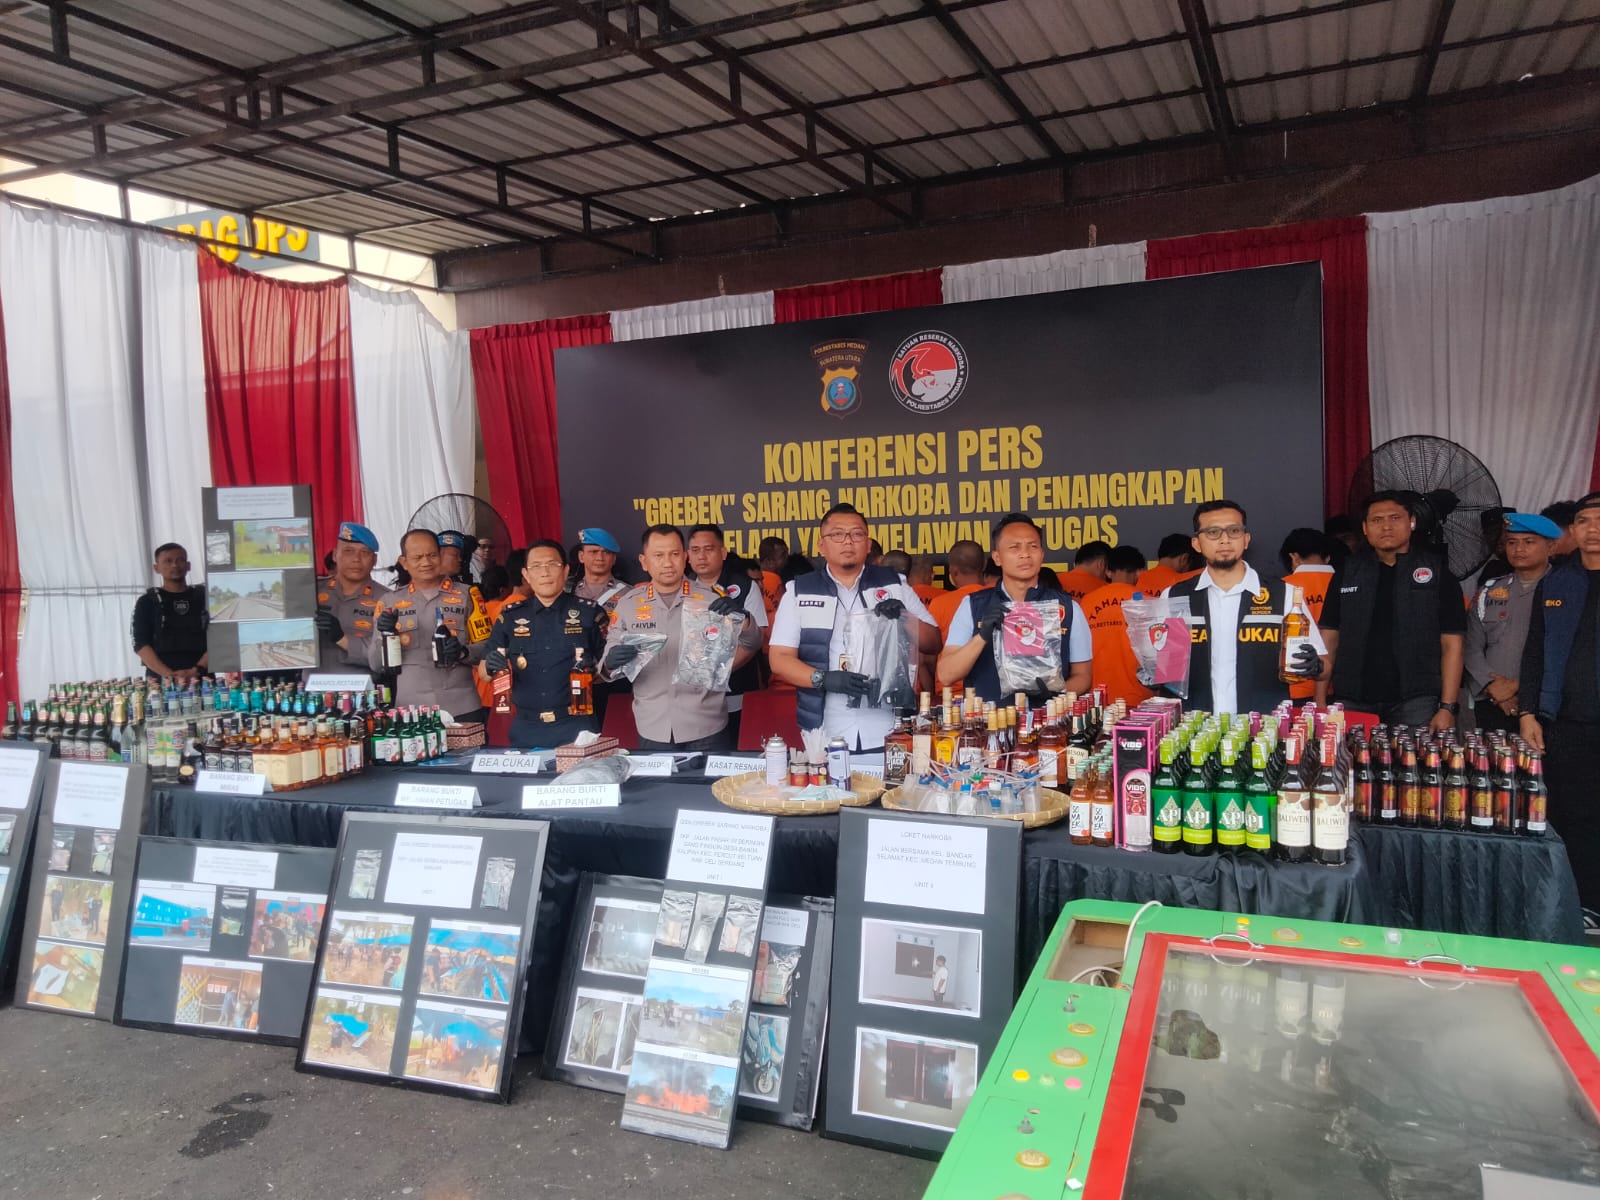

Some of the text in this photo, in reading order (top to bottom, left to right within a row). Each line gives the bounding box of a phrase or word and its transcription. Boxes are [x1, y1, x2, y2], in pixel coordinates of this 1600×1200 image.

[814, 341, 866, 355] POLRESTABES MEDAN
[897, 333, 965, 371] SATUAN RESERSE NARKOBA
[819, 354, 861, 367] SUMATERA UTARA
[905, 377, 963, 411] POLRESTABES MEDAN
[763, 424, 1043, 484] KONFERENSI PERS
[633, 467, 1224, 528] "GREBEK" SARANG NARKOBA DAN PENANGKAPAN
[1037, 514, 1119, 551] TUGAS
[1190, 628, 1208, 643] EA
[1238, 627, 1279, 643] UKAI
[478, 757, 536, 769] BEA CUKAI
[709, 761, 733, 769] KASAT
[209, 773, 235, 782] BARANG
[410, 786, 463, 796] BARANG BUKTI
[536, 785, 608, 796] BARANG BUKTI
[435, 797, 468, 807] PETUGAS
[537, 797, 603, 808] ALAT PANTAU
[1156, 807, 1182, 823] API
[1183, 810, 1210, 825] API
[1218, 810, 1245, 825] API
[900, 831, 953, 841] LOKET NARKOBA
